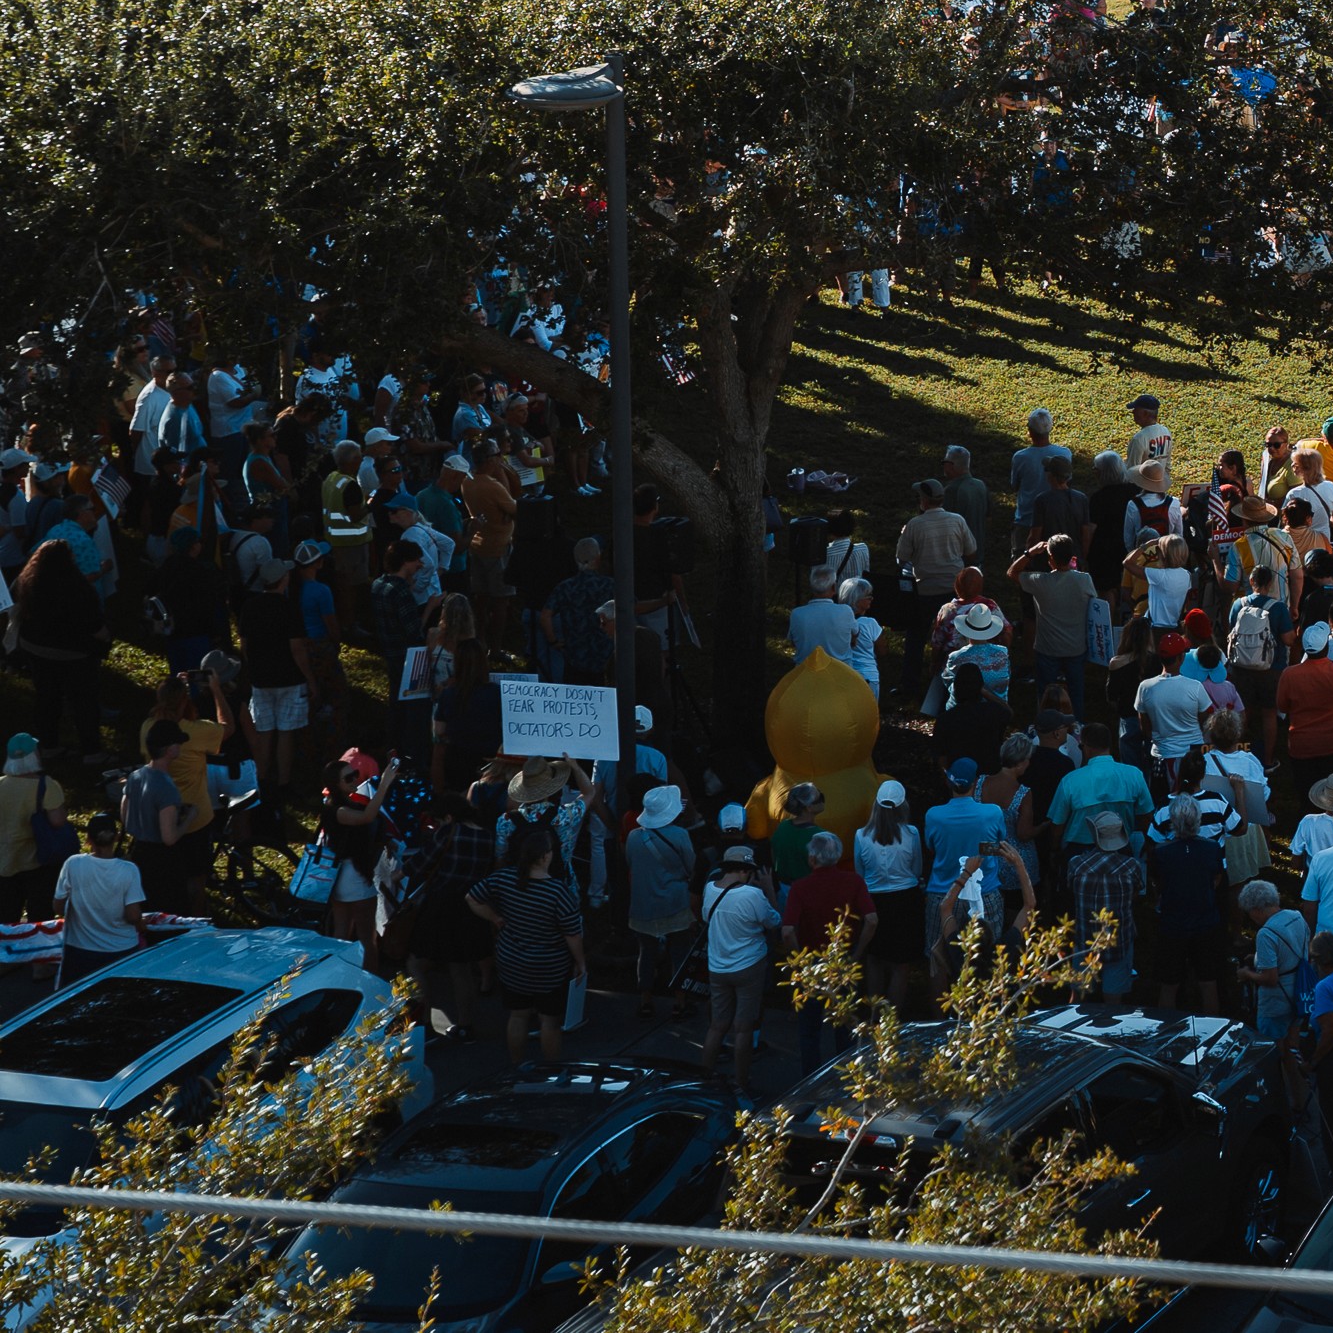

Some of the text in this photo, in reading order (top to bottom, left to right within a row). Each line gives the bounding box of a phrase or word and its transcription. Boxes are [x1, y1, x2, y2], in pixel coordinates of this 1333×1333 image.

[502, 684, 606, 702] DEMOCRACY DOSN'T
[508, 699, 599, 721] FEAR PROTESTS,
[508, 722, 601, 739] DICTATORS DO
